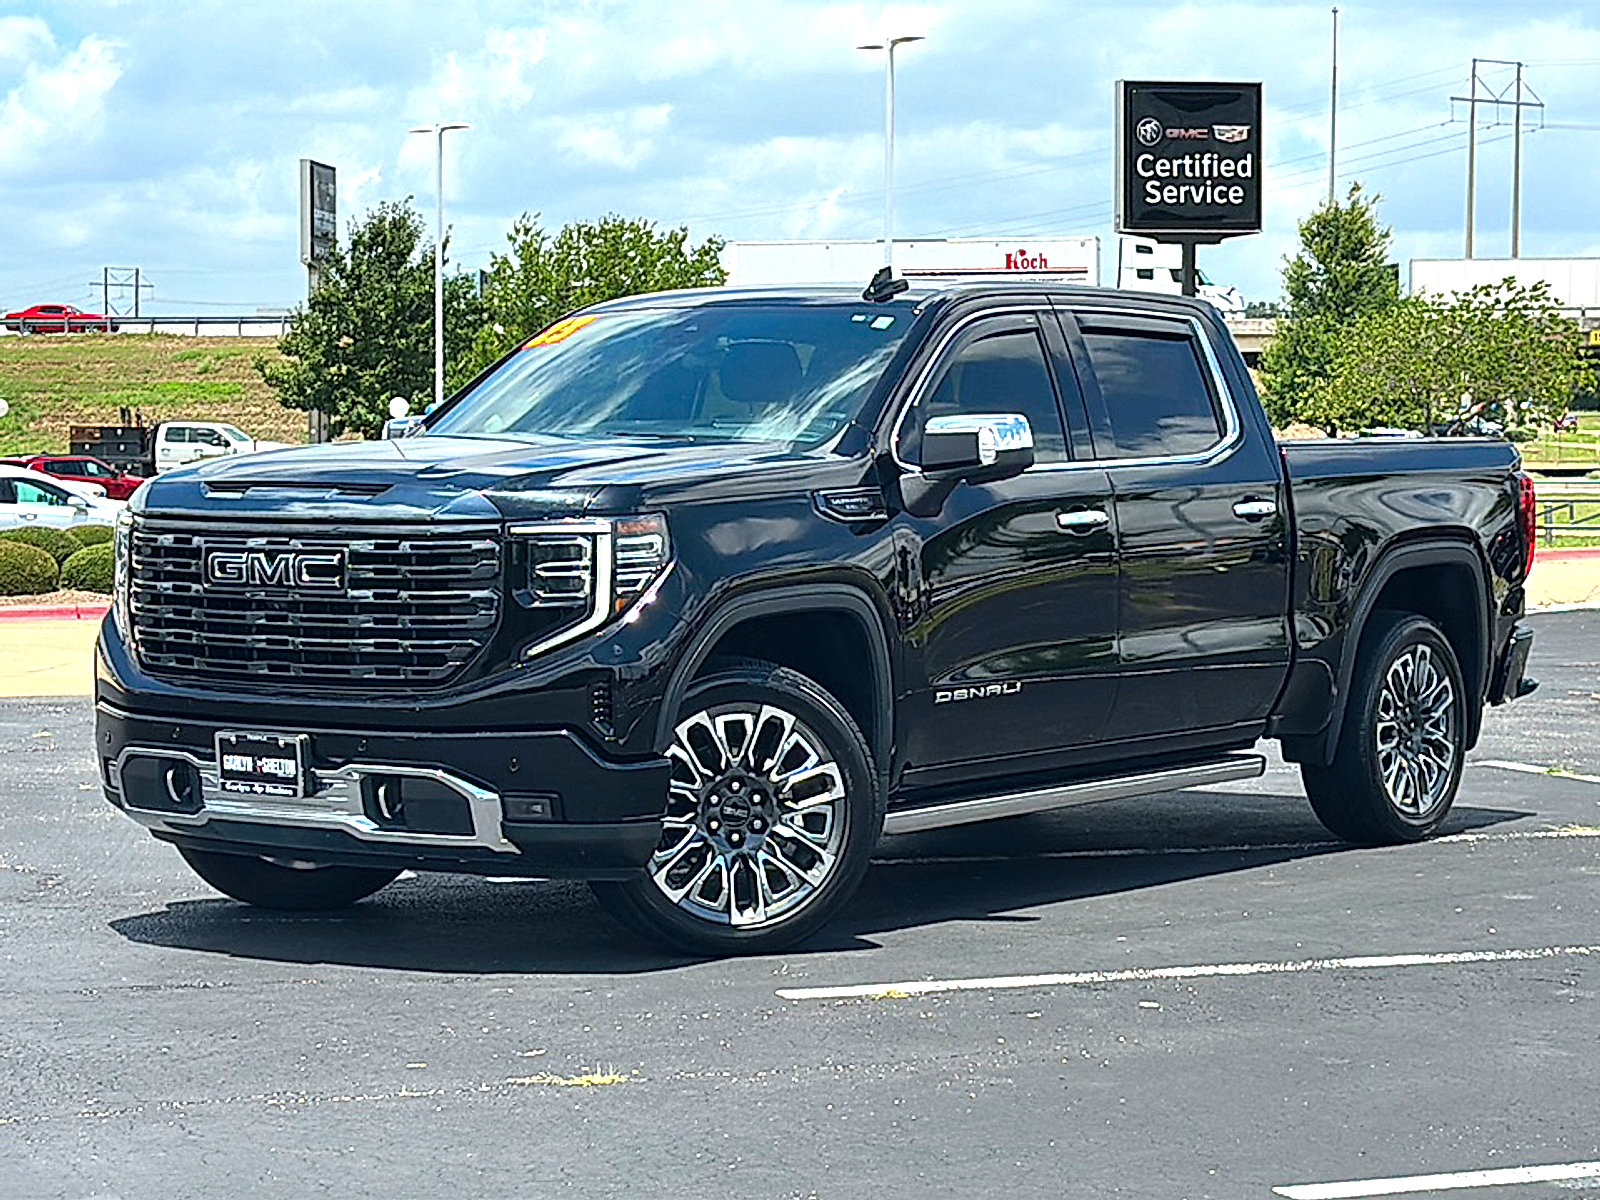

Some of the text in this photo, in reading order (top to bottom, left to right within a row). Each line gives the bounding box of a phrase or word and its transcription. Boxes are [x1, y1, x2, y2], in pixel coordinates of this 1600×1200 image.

[1165, 128, 1209, 139] GMC
[1136, 153, 1252, 178] Certified
[1145, 180, 1244, 204] Service
[1005, 249, 1048, 269] Koch
[208, 552, 342, 588] GMC
[934, 682, 1022, 704] DENALI
